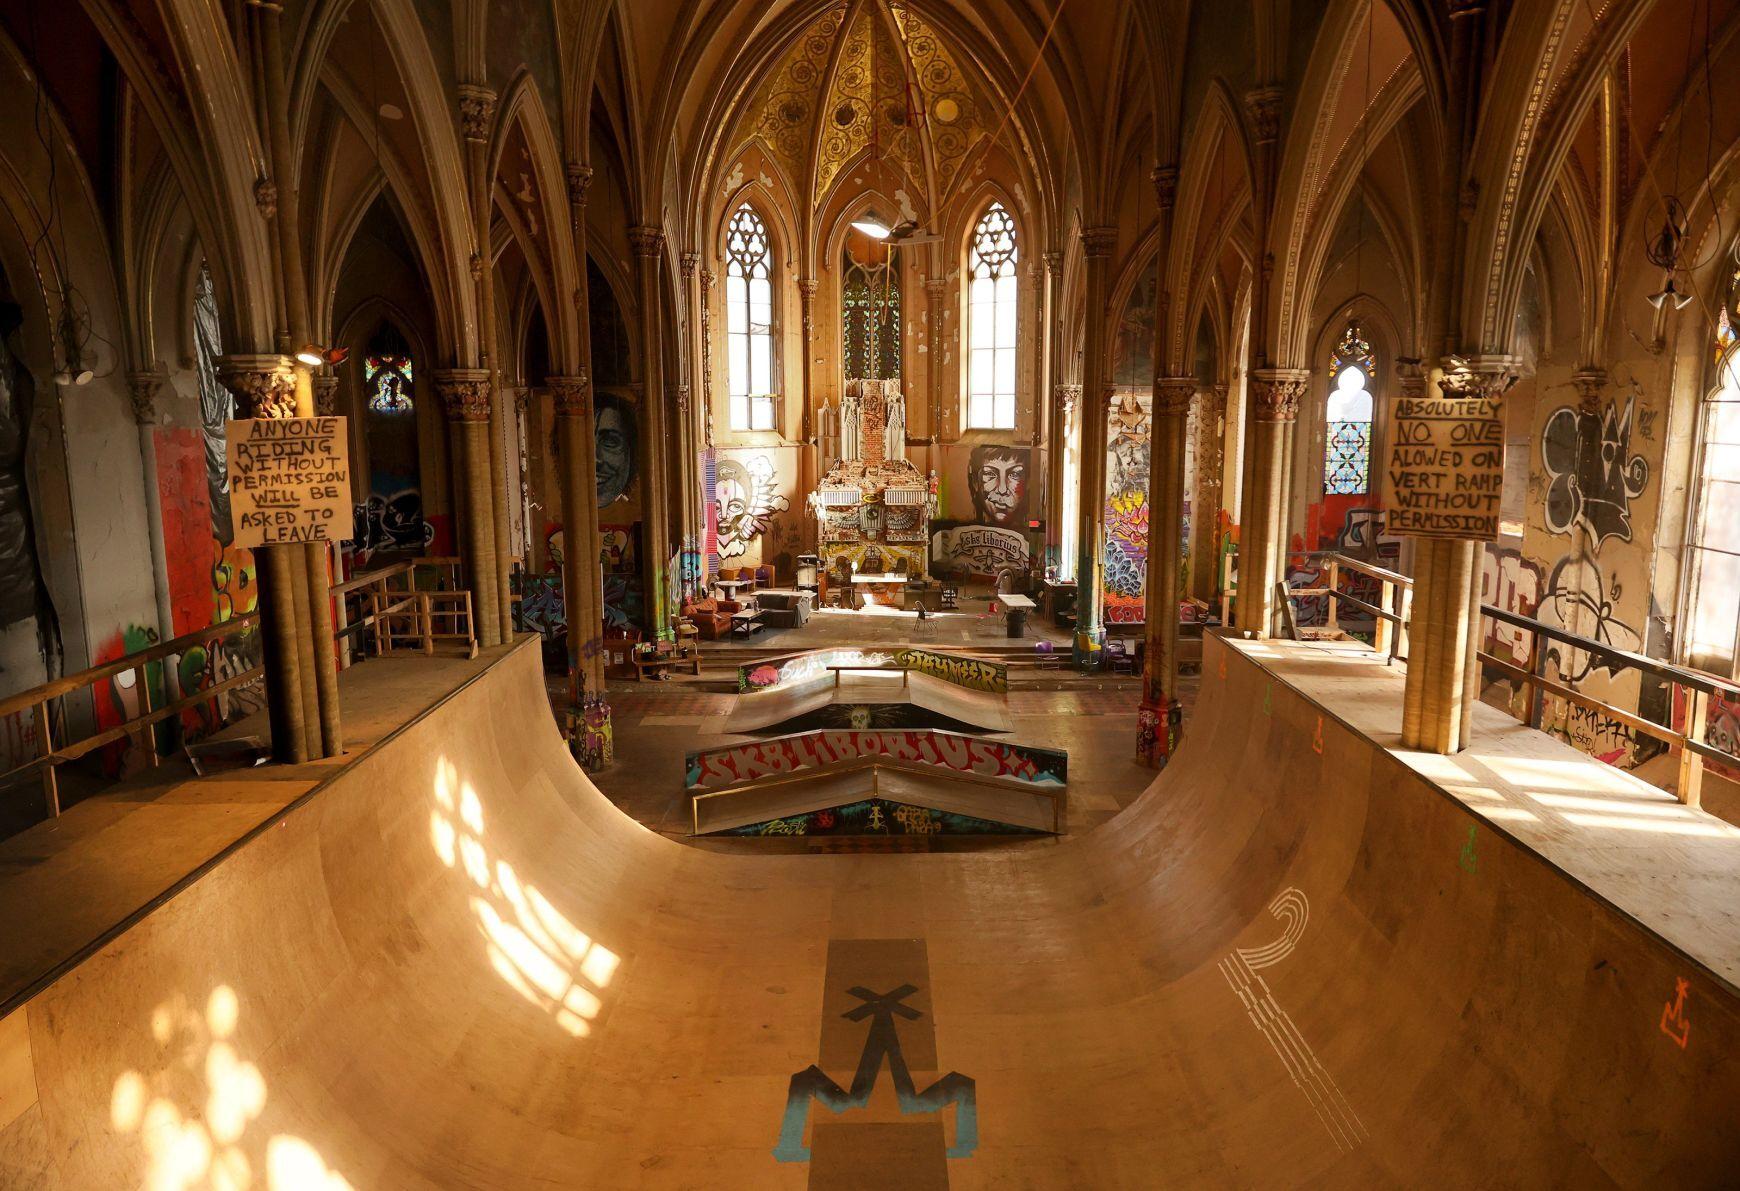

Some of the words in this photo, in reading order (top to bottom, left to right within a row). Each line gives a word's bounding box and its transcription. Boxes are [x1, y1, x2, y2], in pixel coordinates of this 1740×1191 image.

[1395, 400, 1503, 419] ABSOLUTELY
[250, 418, 337, 438] ANYONE
[1397, 422, 1431, 443] NO
[1450, 422, 1503, 442] ONE
[237, 439, 332, 459] RIDING
[1391, 449, 1463, 468] ALOWED
[1471, 450, 1502, 468] ON
[235, 457, 341, 475] WITHOUT
[232, 470, 346, 493] PERMISSION
[1389, 471, 1447, 489] VERT
[1455, 473, 1503, 492] RAMP
[251, 489, 300, 505] WILL
[310, 486, 339, 500] BE
[1395, 490, 1501, 511] WITHOUT
[241, 511, 296, 530] ASKED
[304, 508, 334, 520] TO
[1389, 509, 1498, 533] PERMISSION
[262, 524, 328, 543] LEAVE
